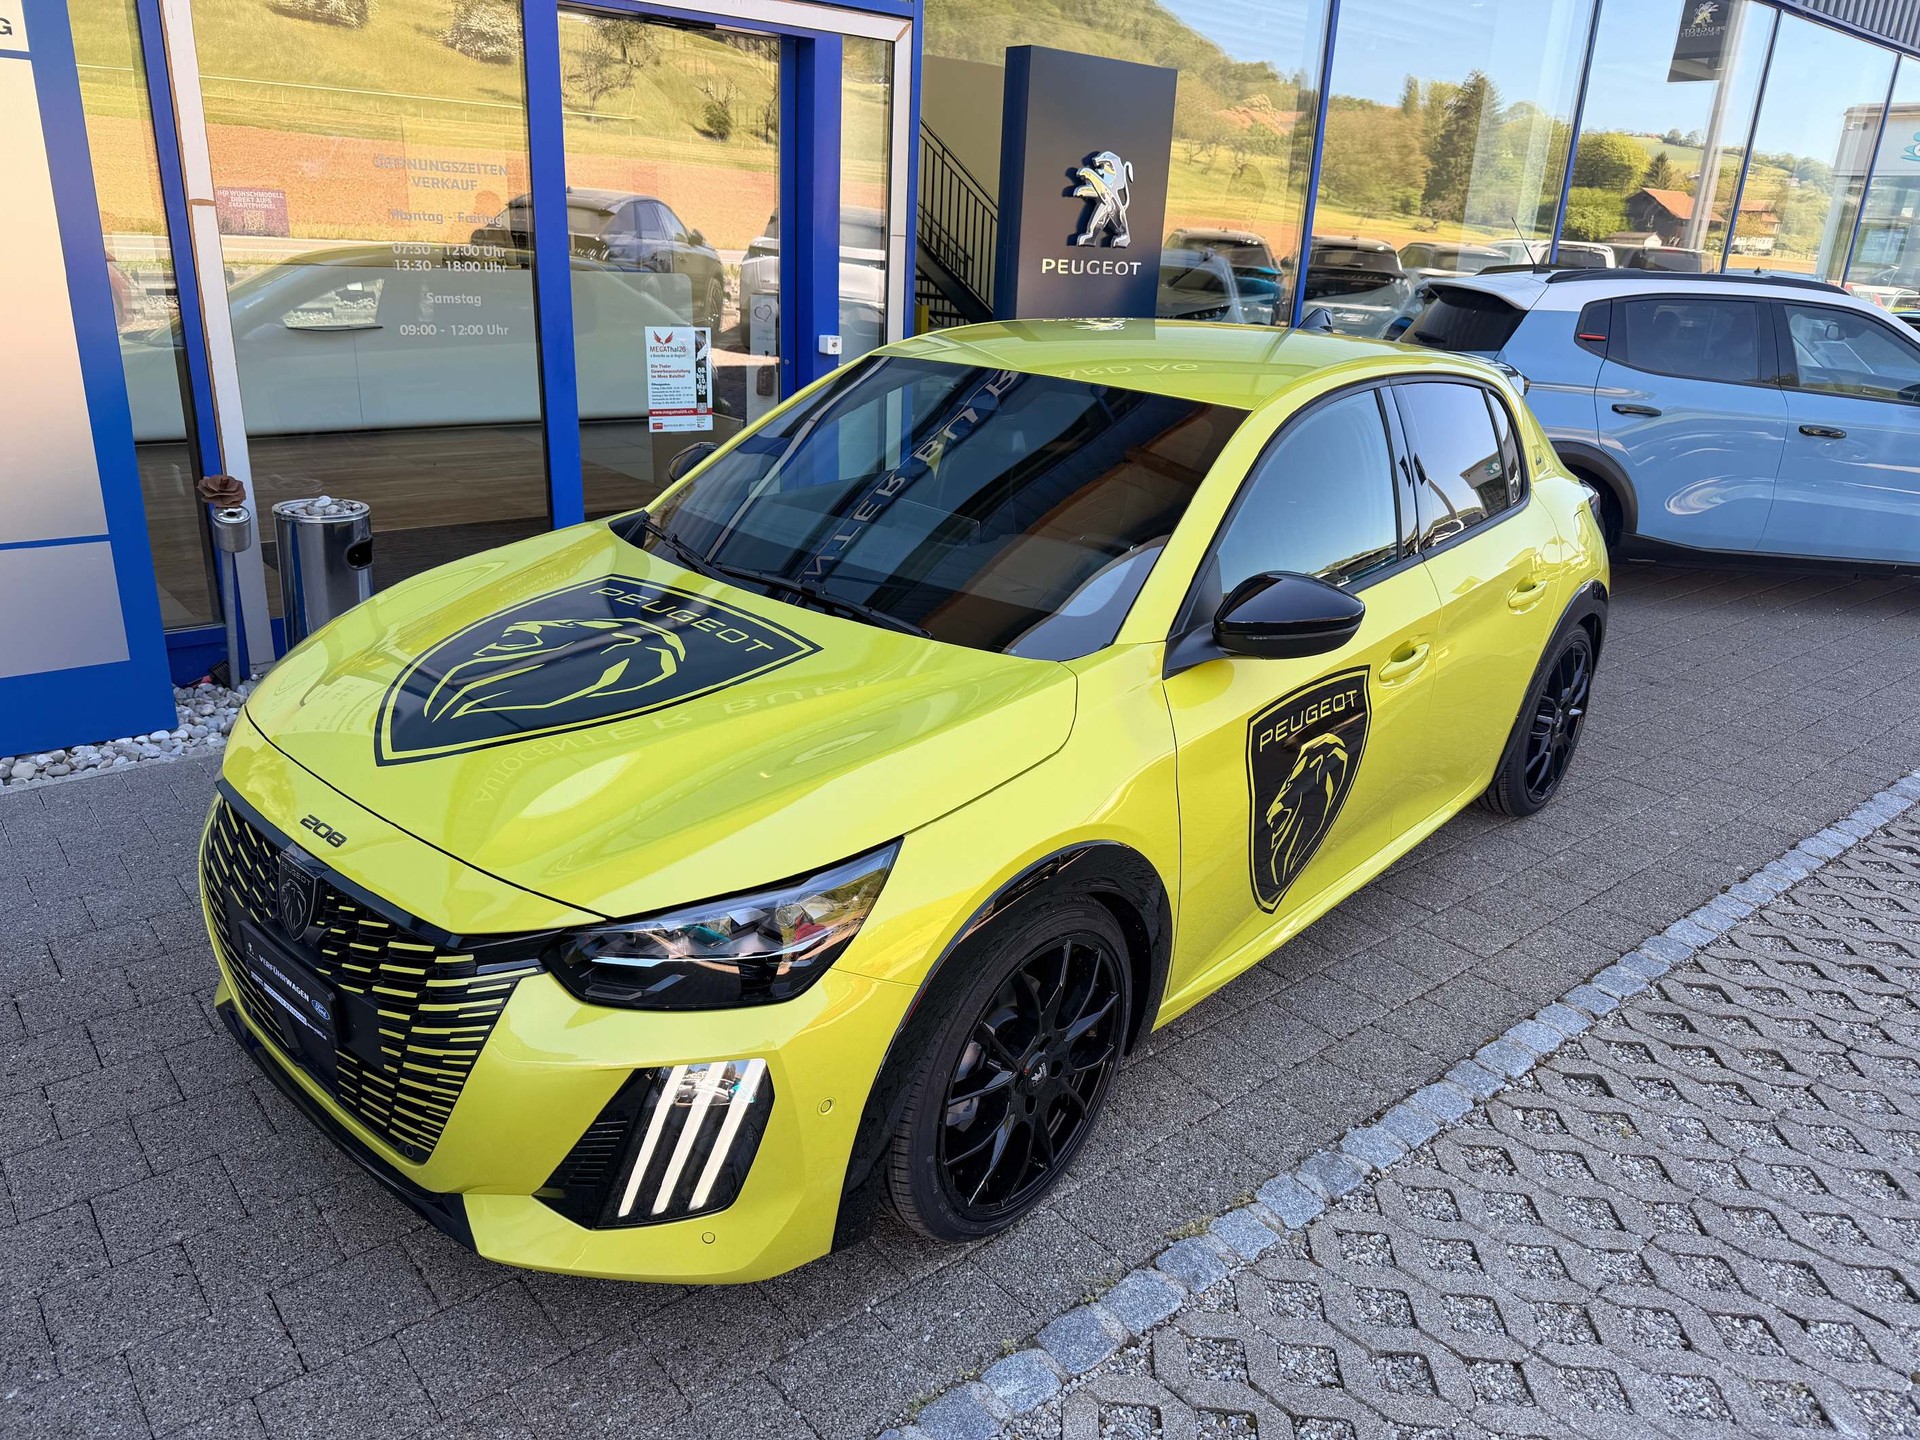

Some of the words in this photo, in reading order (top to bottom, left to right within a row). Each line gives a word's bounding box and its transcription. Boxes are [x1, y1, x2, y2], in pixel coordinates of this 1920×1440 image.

[411, 176, 478, 191] VERKAUF
[390, 208, 444, 225] Montag
[392, 243, 431, 255] 07:30
[446, 245, 480, 256] 12:00
[484, 245, 506, 257] Uhr
[395, 259, 432, 271] 13:30
[446, 260, 480, 272] 18:00
[485, 261, 507, 273] Uhr
[1041, 258, 1142, 276] PEUGEOT
[426, 292, 482, 307] Samstag
[400, 324, 437, 336] 09:00
[451, 325, 483, 336] 12:00
[487, 324, 509, 335] Uhr
[590, 587, 774, 652] PEUGEOT
[1259, 689, 1358, 753] PEUGEOT
[299, 814, 348, 848] 208
[281, 860, 312, 887] PEUGEOT
